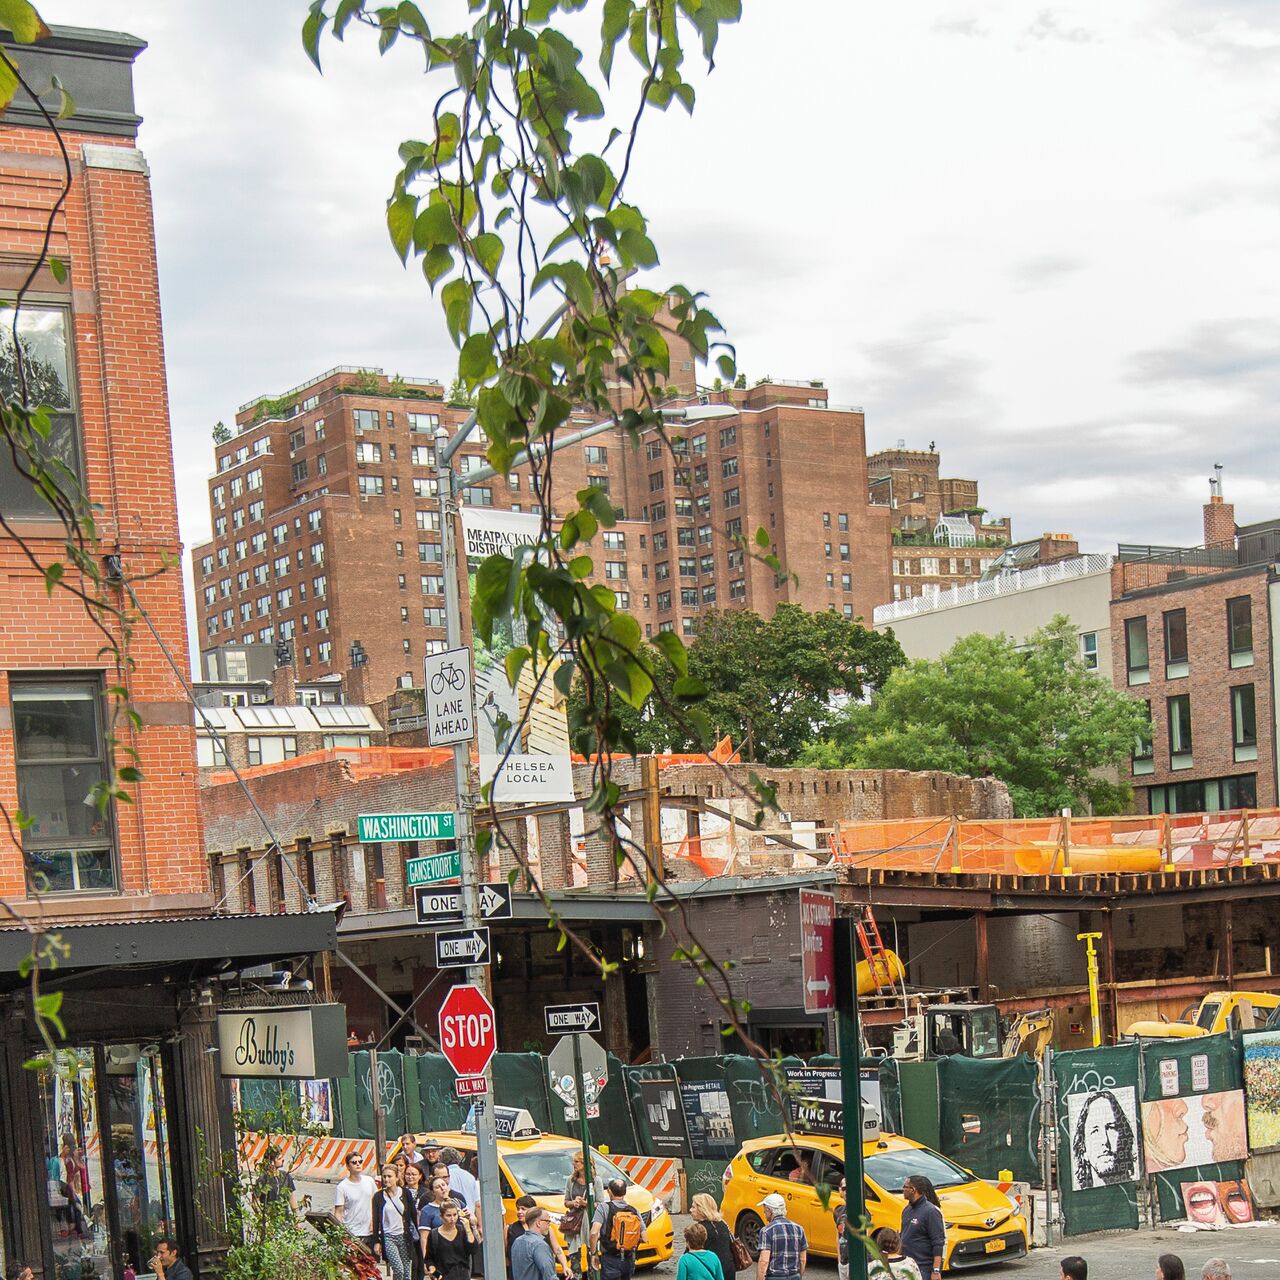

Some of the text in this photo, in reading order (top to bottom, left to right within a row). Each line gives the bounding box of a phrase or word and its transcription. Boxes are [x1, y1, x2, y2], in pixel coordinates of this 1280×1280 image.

[436, 699, 464, 716] LANE
[434, 719, 469, 737] AHEAD
[497, 761, 555, 772] CHELSEA
[506, 773, 547, 783] LOCAL
[362, 816, 453, 838] WASHINGTON ST
[409, 859, 453, 883] GANSEVOORT
[430, 894, 497, 911] ONE AY
[444, 940, 481, 956] ONE WAY
[553, 1012, 591, 1025] ONE WAY
[443, 1013, 492, 1048] STOP
[235, 1017, 294, 1073] Bubby's
[812, 1070, 837, 1078] Progress:
[459, 1078, 485, 1093] ALL WAY
